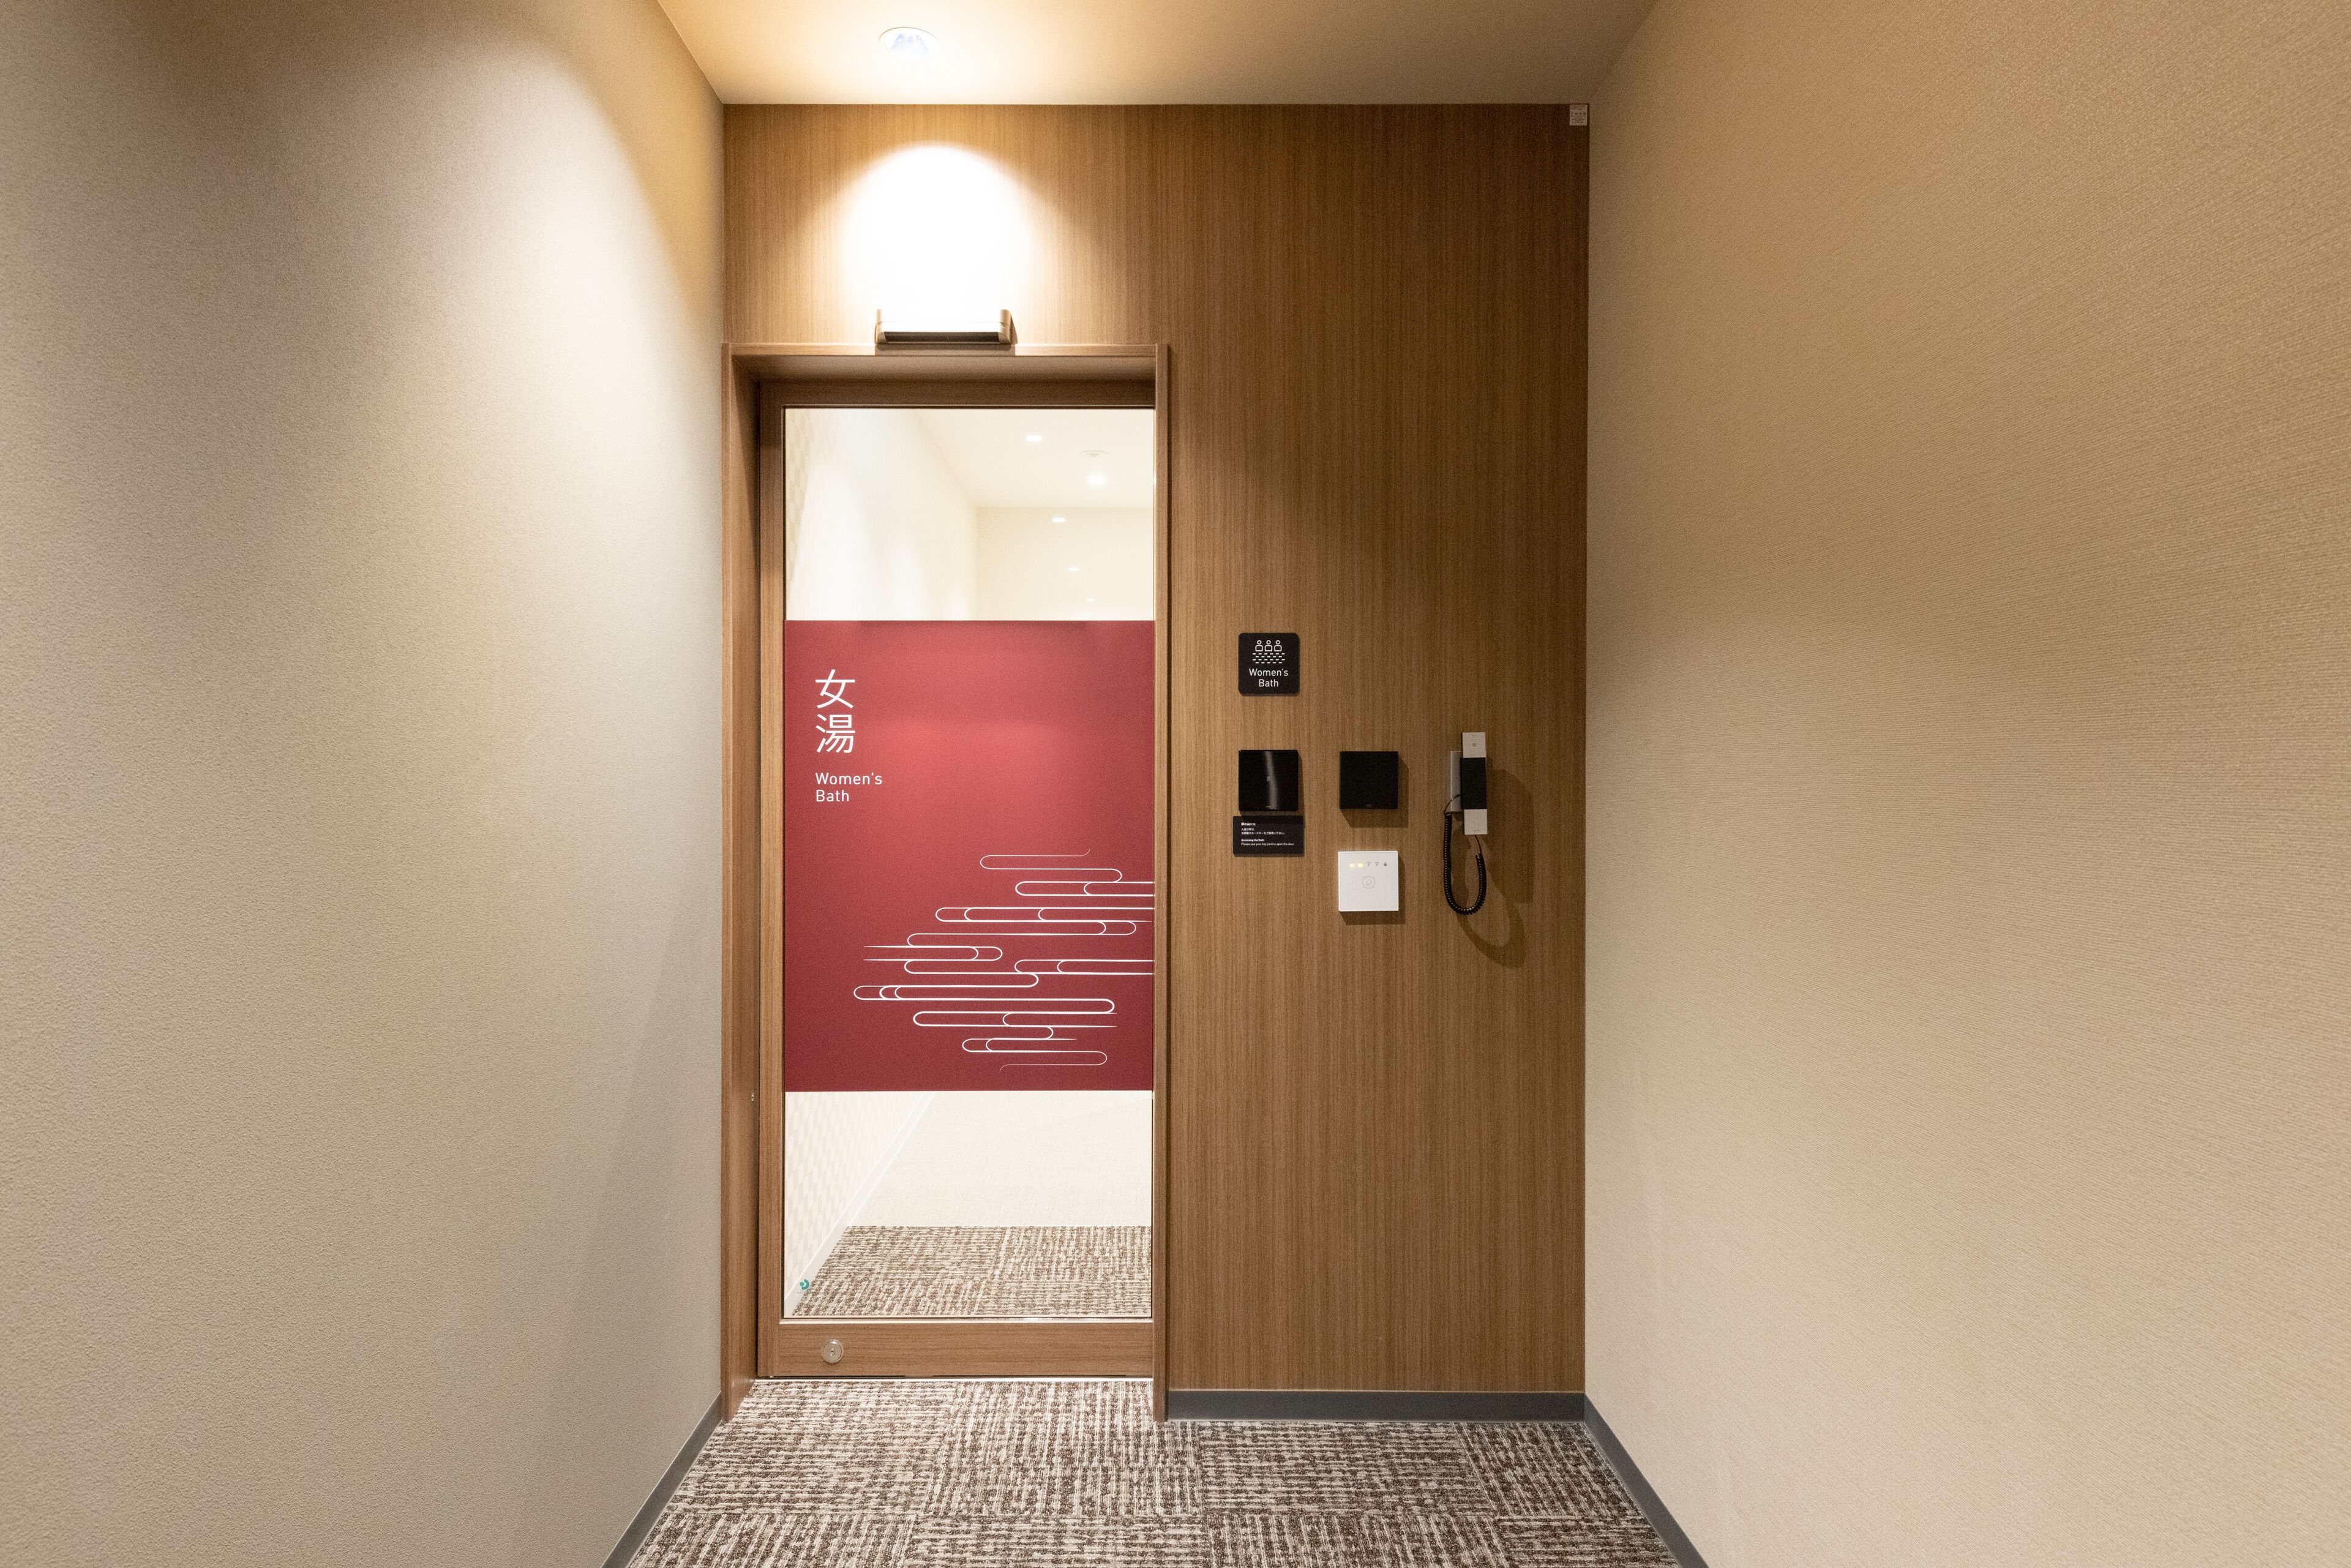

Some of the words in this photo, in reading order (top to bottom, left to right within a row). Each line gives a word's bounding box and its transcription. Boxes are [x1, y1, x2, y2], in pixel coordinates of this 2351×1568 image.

[1249, 668, 1289, 677] Women's
[1259, 678, 1278, 687] Bath
[815, 669, 855, 753] 女湯
[815, 772, 882, 785] Women's
[816, 790, 849, 802] Bath
